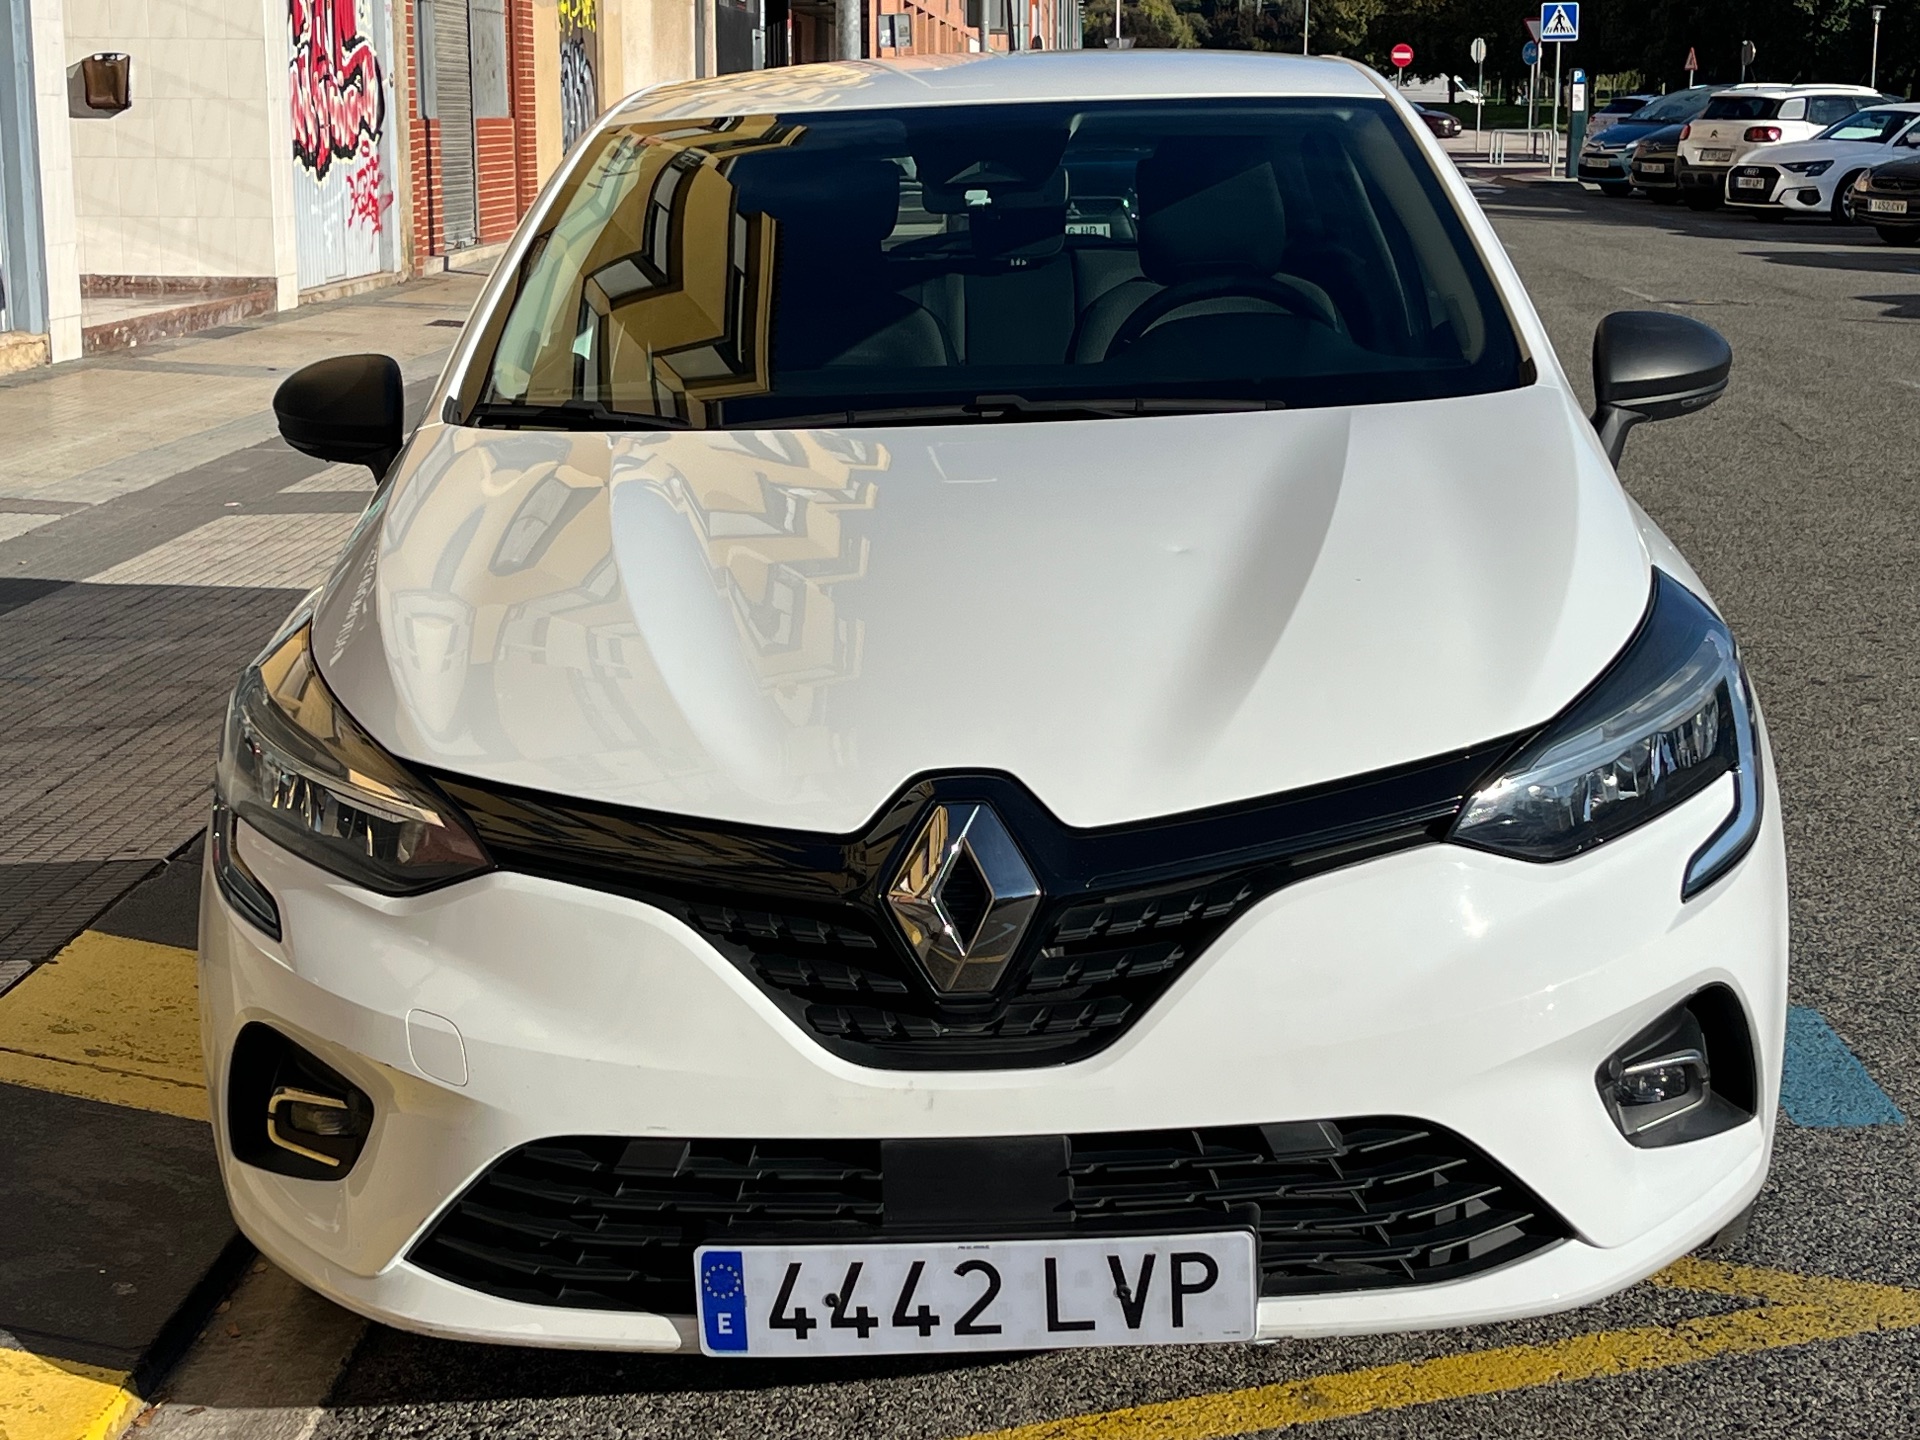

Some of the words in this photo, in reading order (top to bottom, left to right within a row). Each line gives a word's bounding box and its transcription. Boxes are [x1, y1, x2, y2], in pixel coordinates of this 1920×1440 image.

[1573, 70, 1582, 82] P
[768, 1259, 1003, 1340] 4442
[1045, 1251, 1219, 1332] LVP
[717, 1312, 733, 1335] E
